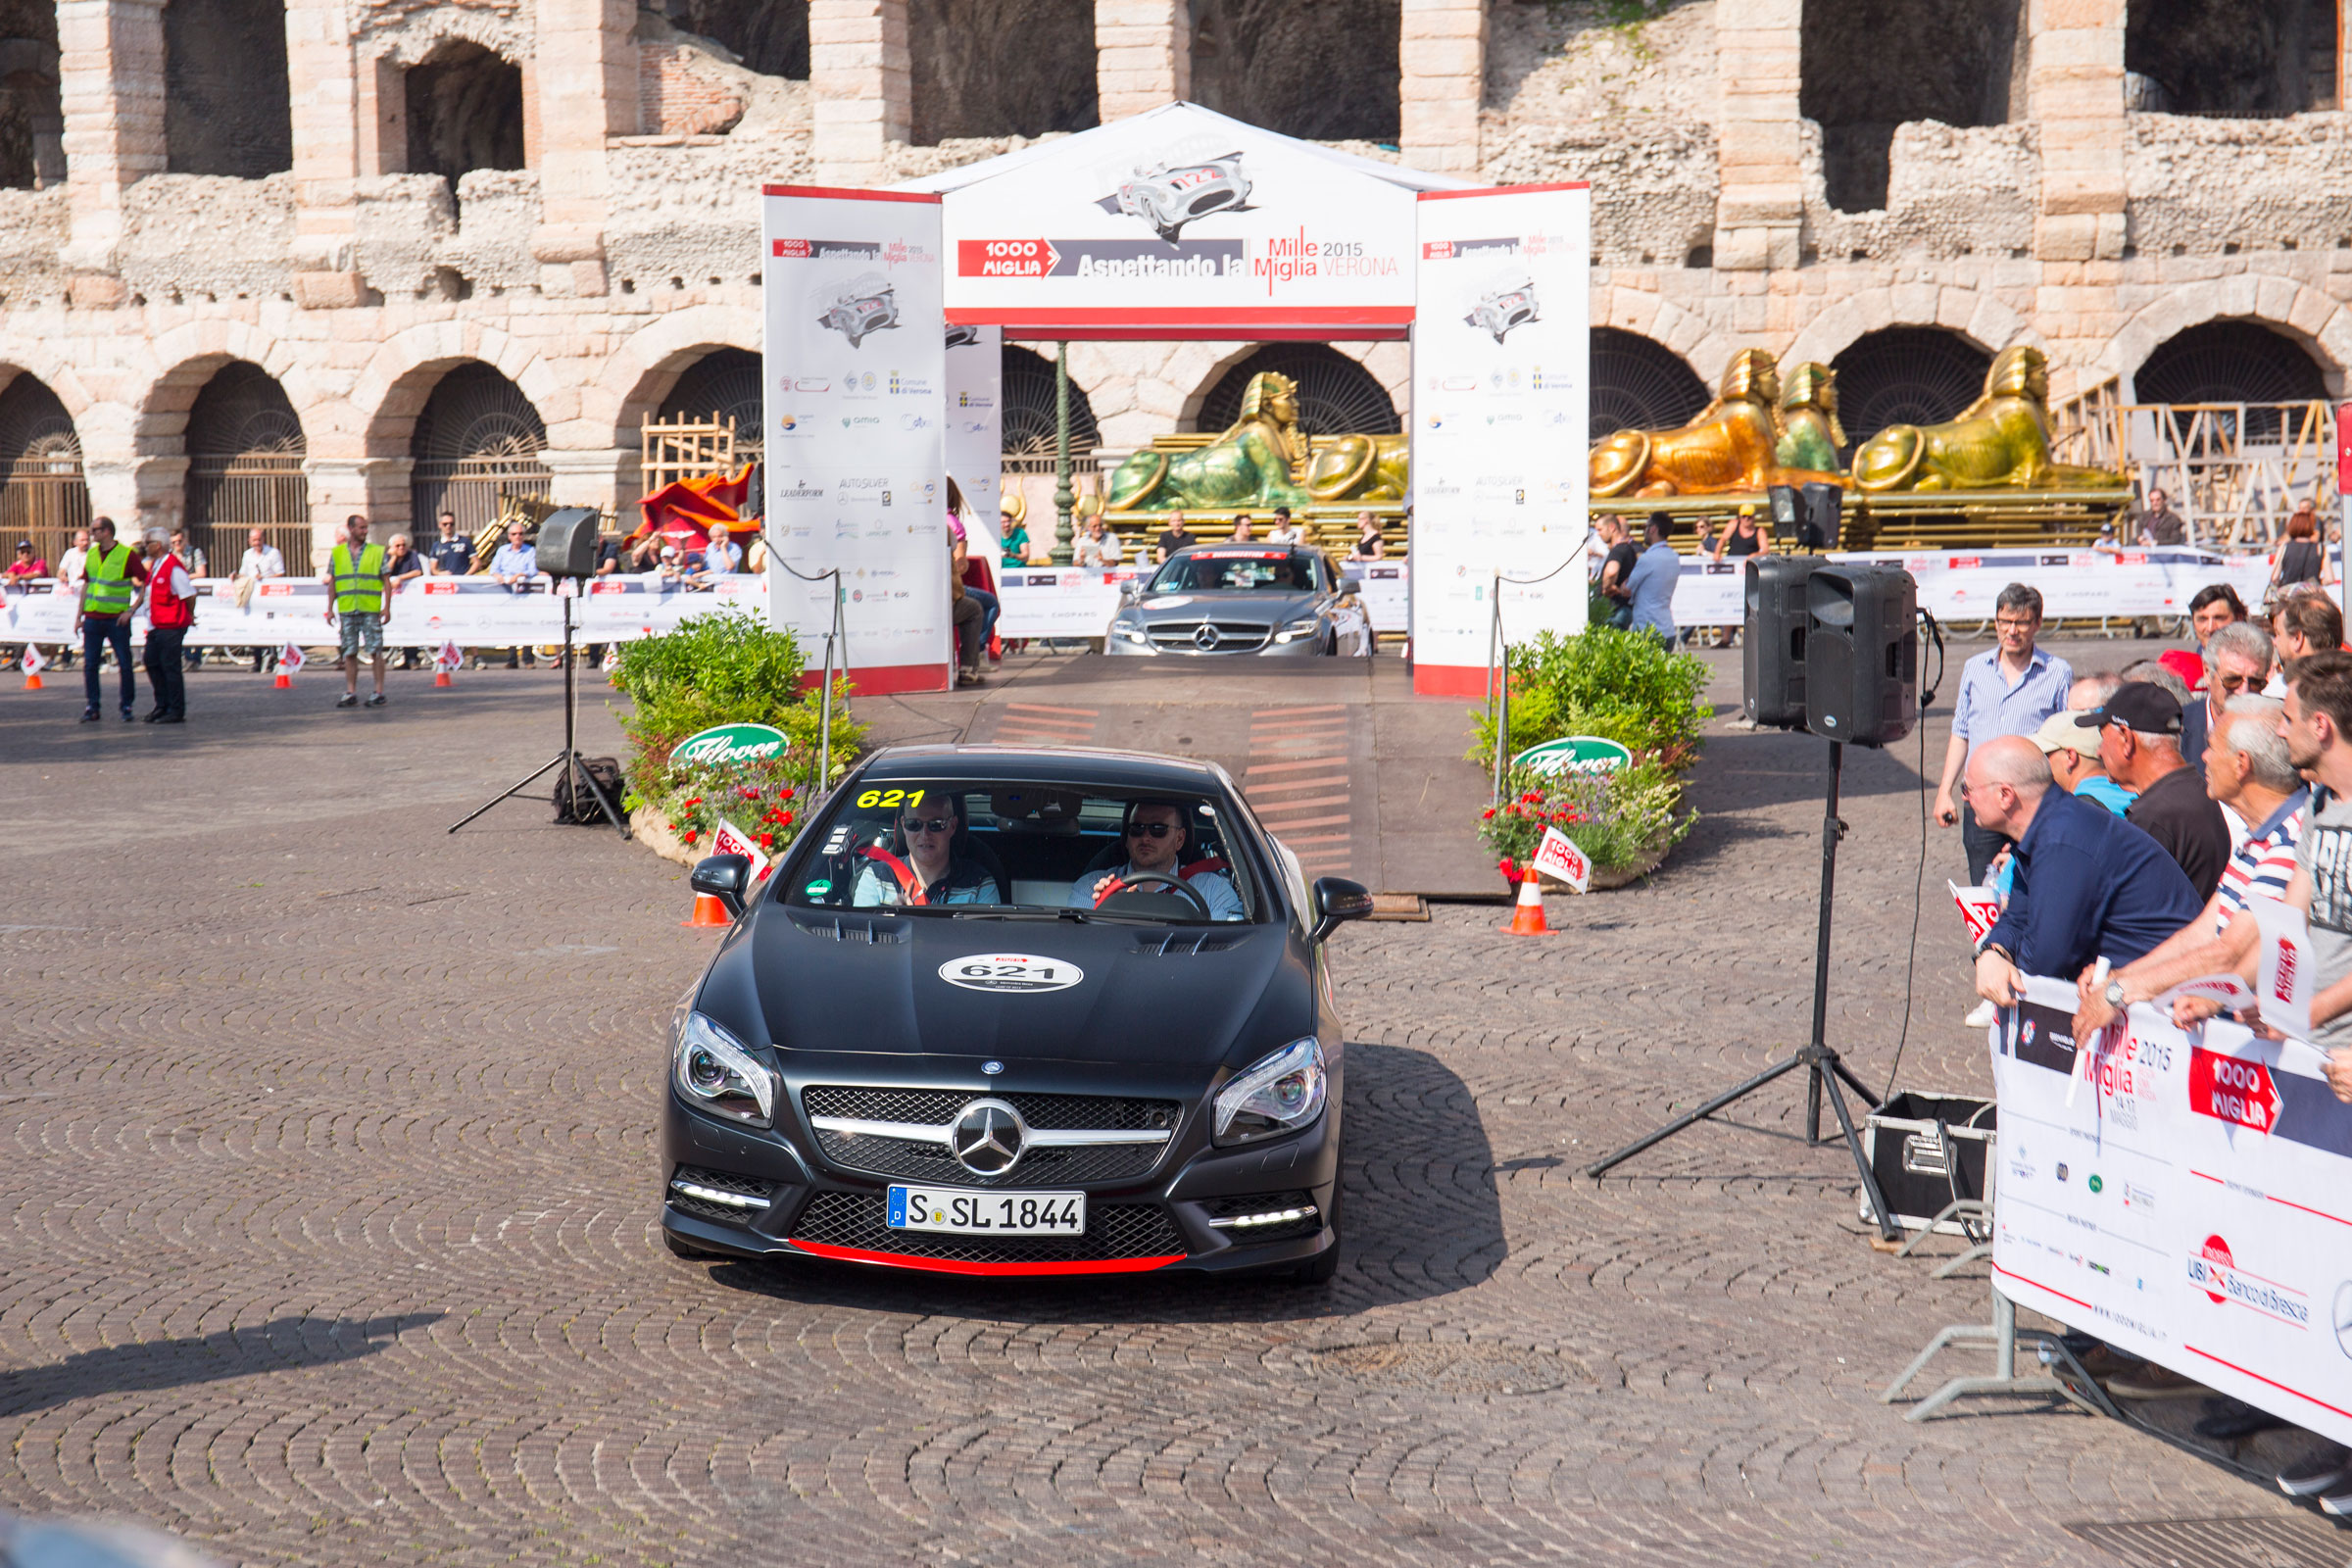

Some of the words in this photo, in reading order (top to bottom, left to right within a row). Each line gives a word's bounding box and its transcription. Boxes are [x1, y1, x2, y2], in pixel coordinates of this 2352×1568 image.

[986, 242, 1038, 257] 1000
[1269, 226, 1318, 257] Mille
[1324, 243, 1363, 257] 2015
[983, 261, 1042, 276] MIGLIA
[1078, 254, 1219, 277] Aspettando
[1224, 254, 1244, 276] la
[1254, 259, 1317, 296] Miglia
[1325, 258, 1398, 276] VERONA
[857, 789, 925, 808] 621
[1543, 851, 1578, 877] MIGLIA
[1550, 840, 1579, 865] 1000
[960, 965, 1054, 979] 621
[2138, 1041, 2172, 1072] 2015
[2213, 1058, 2260, 1093] 1000
[2212, 1090, 2267, 1128] MIGLIA
[894, 1210, 902, 1220] D
[909, 1194, 928, 1223] S
[951, 1198, 991, 1229] SL
[999, 1199, 1078, 1229] 1844
